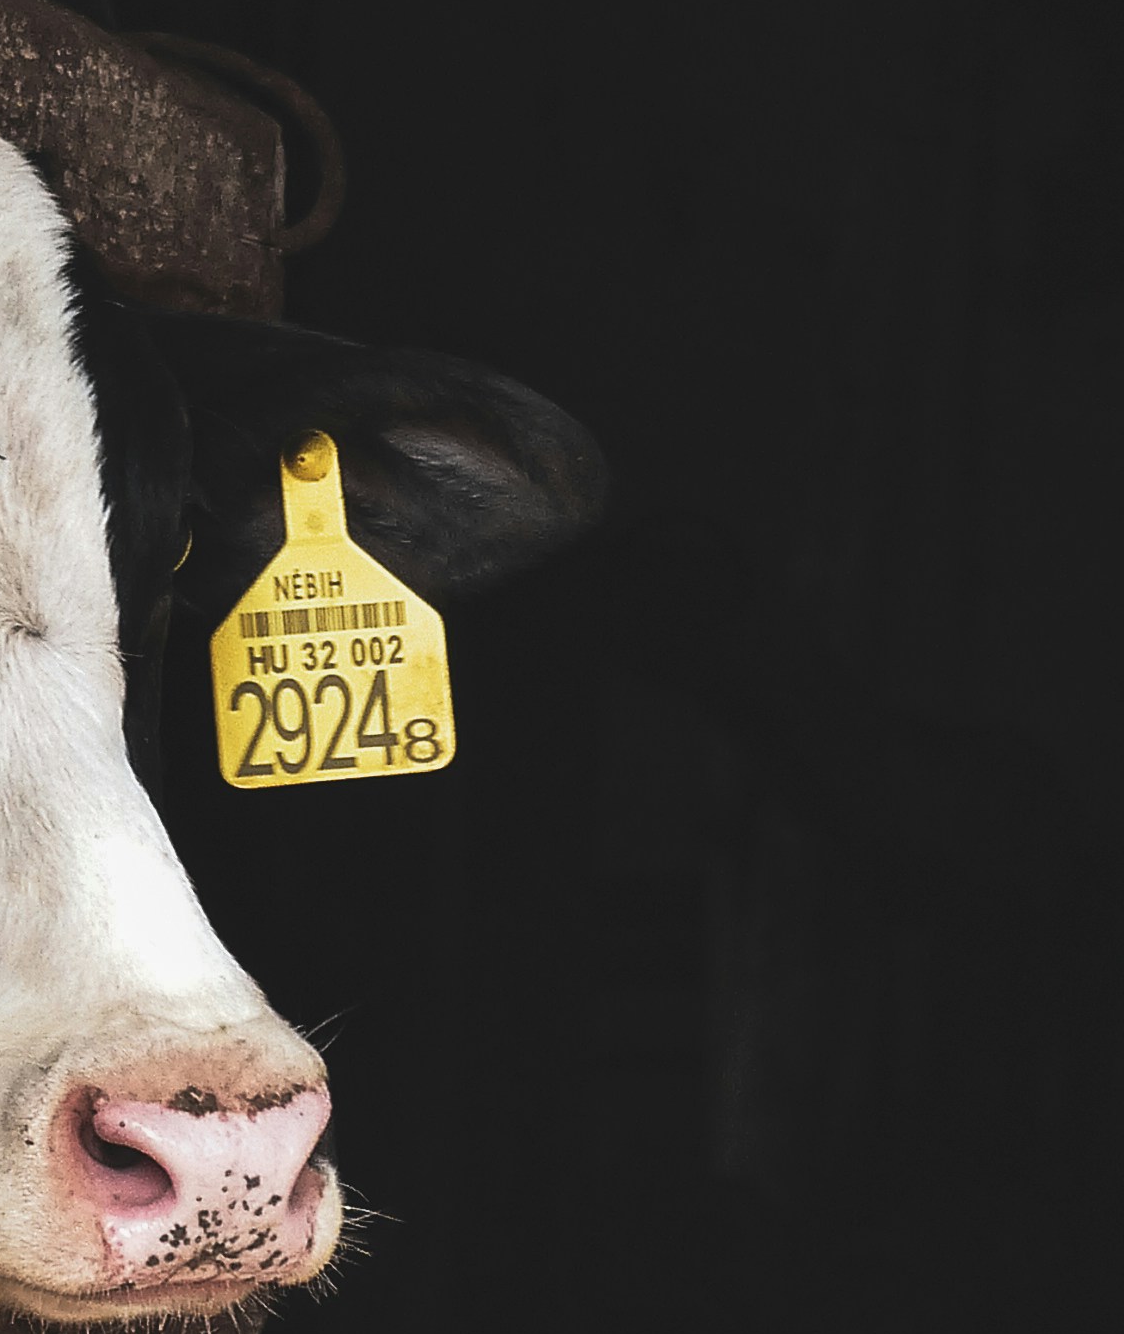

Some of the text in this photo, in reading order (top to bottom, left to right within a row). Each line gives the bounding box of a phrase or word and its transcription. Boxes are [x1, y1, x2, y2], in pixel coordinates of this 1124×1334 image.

[273, 569, 343, 601] NÉBIH
[247, 635, 404, 675] HU 32 002
